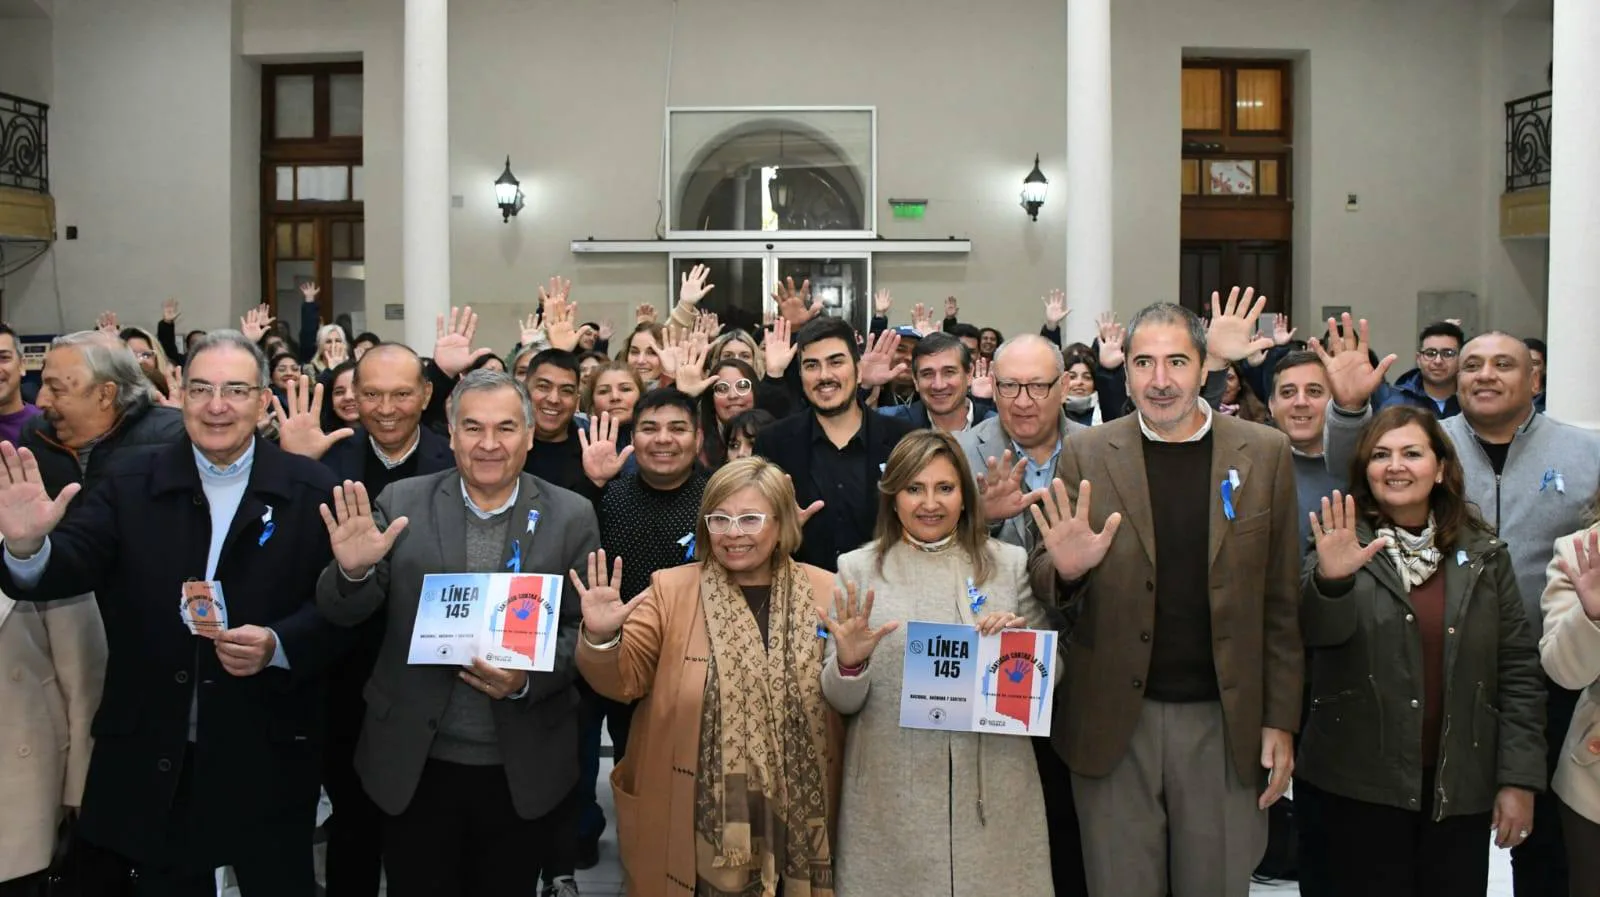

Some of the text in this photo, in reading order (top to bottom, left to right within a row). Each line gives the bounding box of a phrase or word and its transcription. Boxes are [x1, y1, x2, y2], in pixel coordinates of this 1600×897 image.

[441, 585, 479, 602] LÍNEA
[445, 604, 470, 618] 145
[928, 635, 968, 659] LÍNEA
[1011, 651, 1032, 660] CONTRA
[1031, 656, 1038, 664] LA
[934, 660, 960, 679] 145
